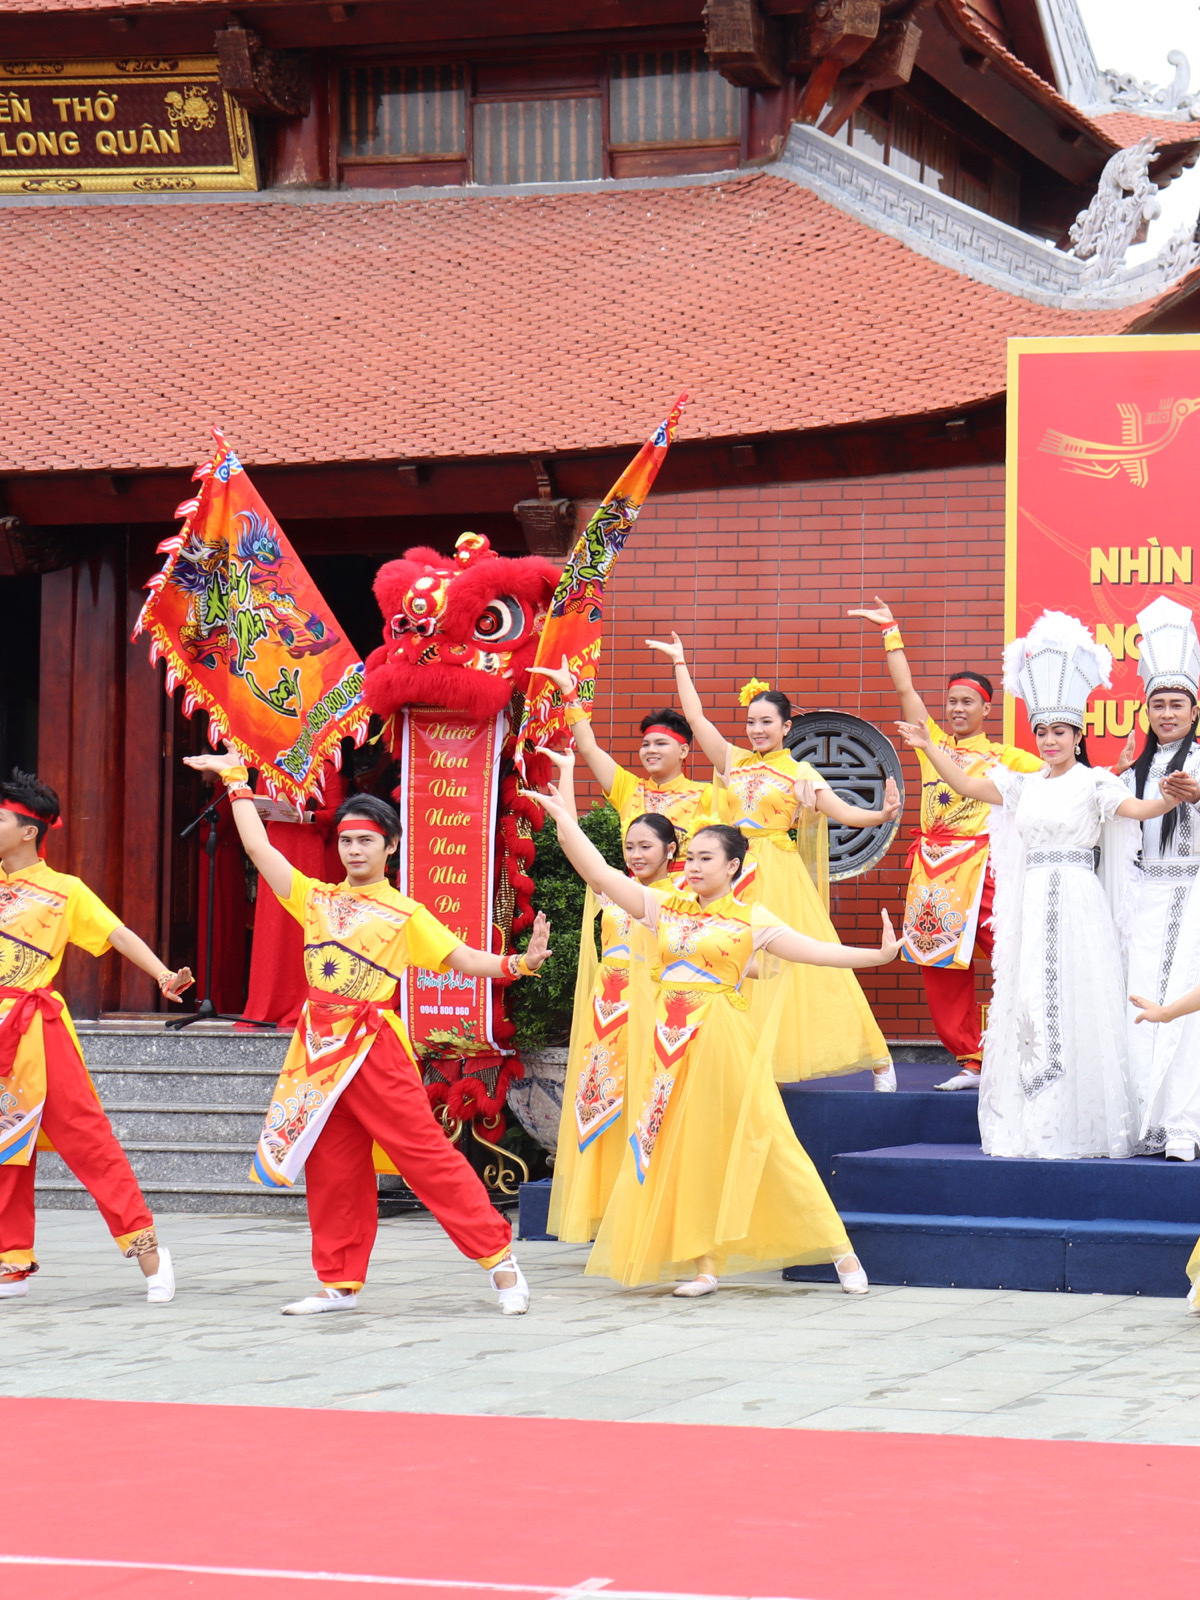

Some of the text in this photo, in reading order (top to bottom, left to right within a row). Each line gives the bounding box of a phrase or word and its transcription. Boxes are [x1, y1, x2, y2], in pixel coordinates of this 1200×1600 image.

[53, 90, 118, 122] THỜ
[0, 122, 181, 157] LONG QUÂN
[1090, 537, 1194, 584] NHÌN
[323, 687, 348, 714] 800
[426, 722, 476, 740] Nước
[429, 750, 469, 768] Non
[428, 778, 468, 797] Vẫn
[425, 808, 471, 827] Nước
[429, 837, 467, 855] Non
[429, 865, 468, 884] Nhà
[435, 895, 461, 913] Đó
[420, 1005, 470, 1016] 0948 800 860
